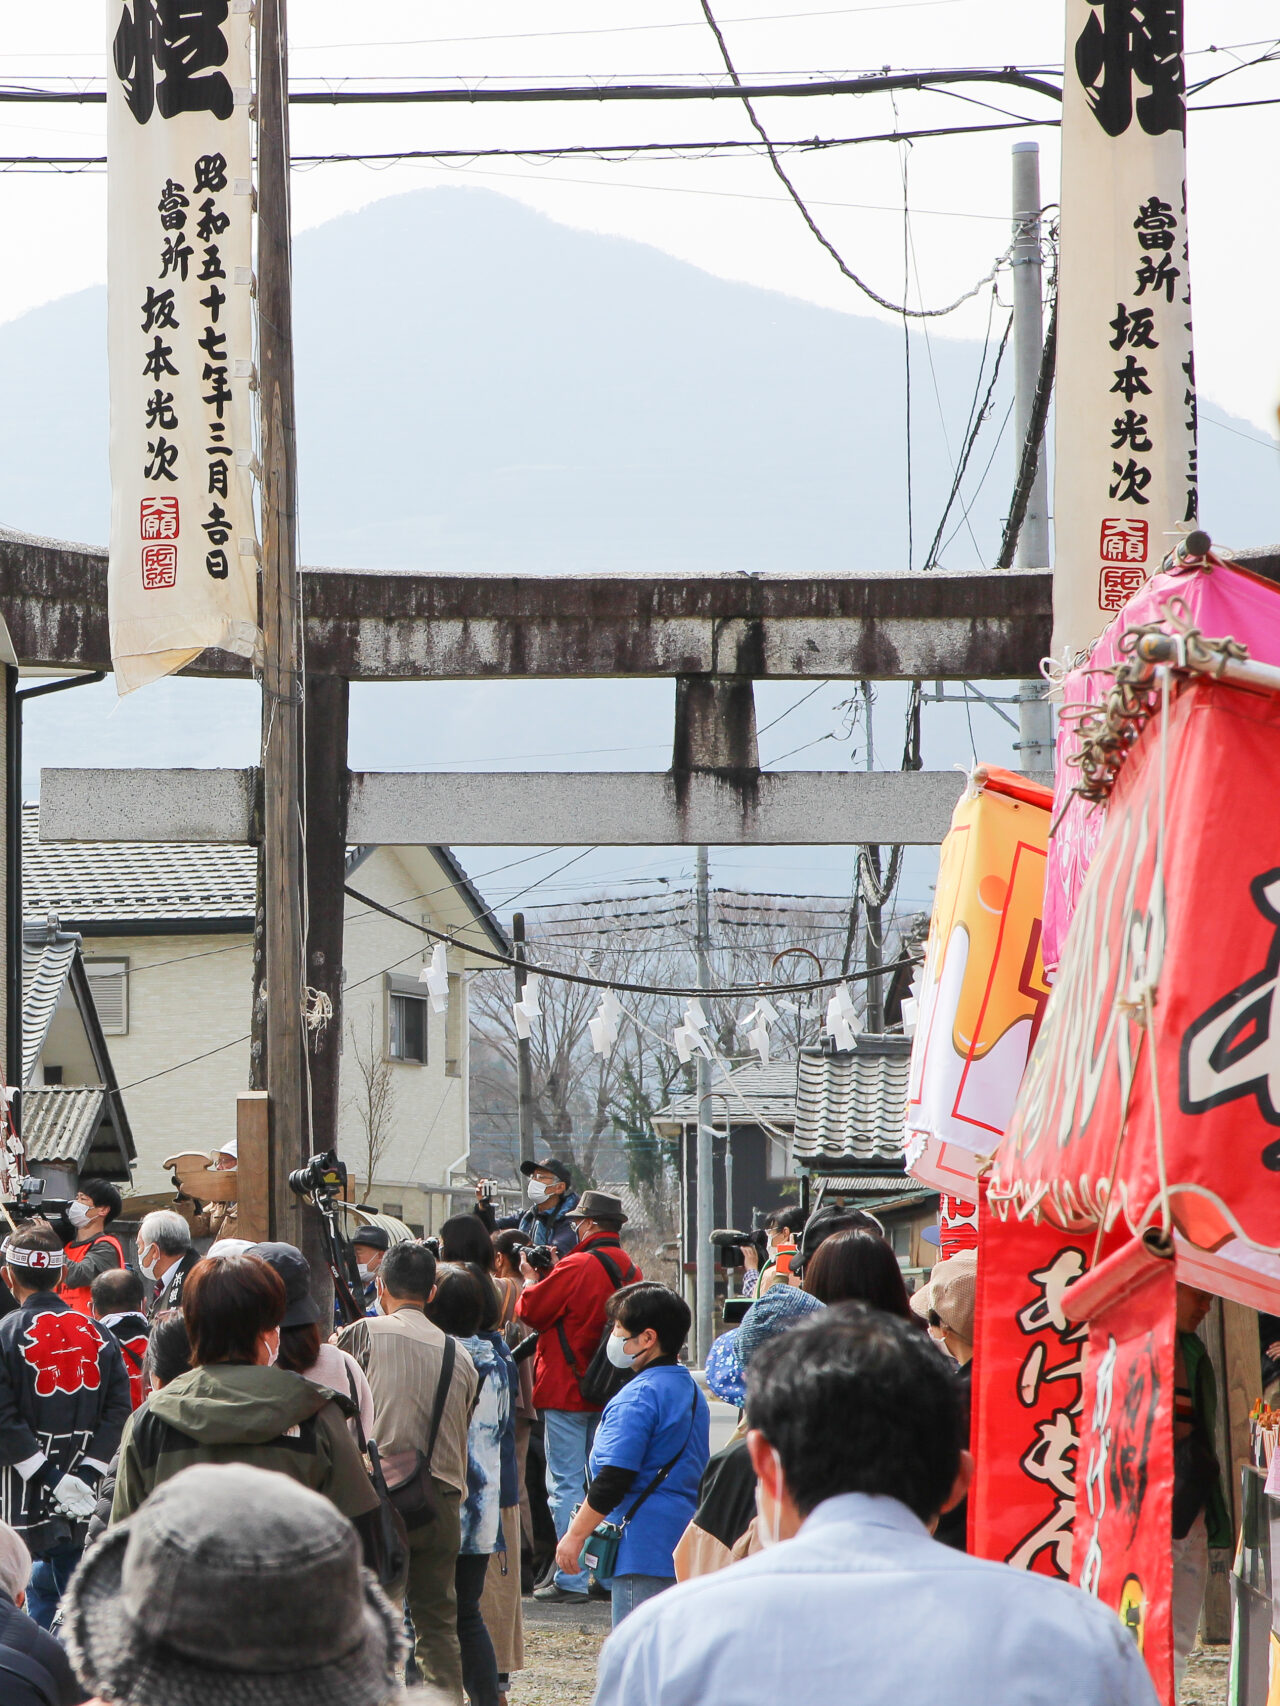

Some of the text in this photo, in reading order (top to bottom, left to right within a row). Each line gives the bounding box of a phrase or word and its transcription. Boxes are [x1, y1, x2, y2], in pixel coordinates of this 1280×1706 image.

[141, 286, 180, 482] 坂本光次
[1109, 303, 1160, 505] 坂本光次
[33, 1252, 45, 1267] 上
[18, 1310, 109, 1397] 祭
